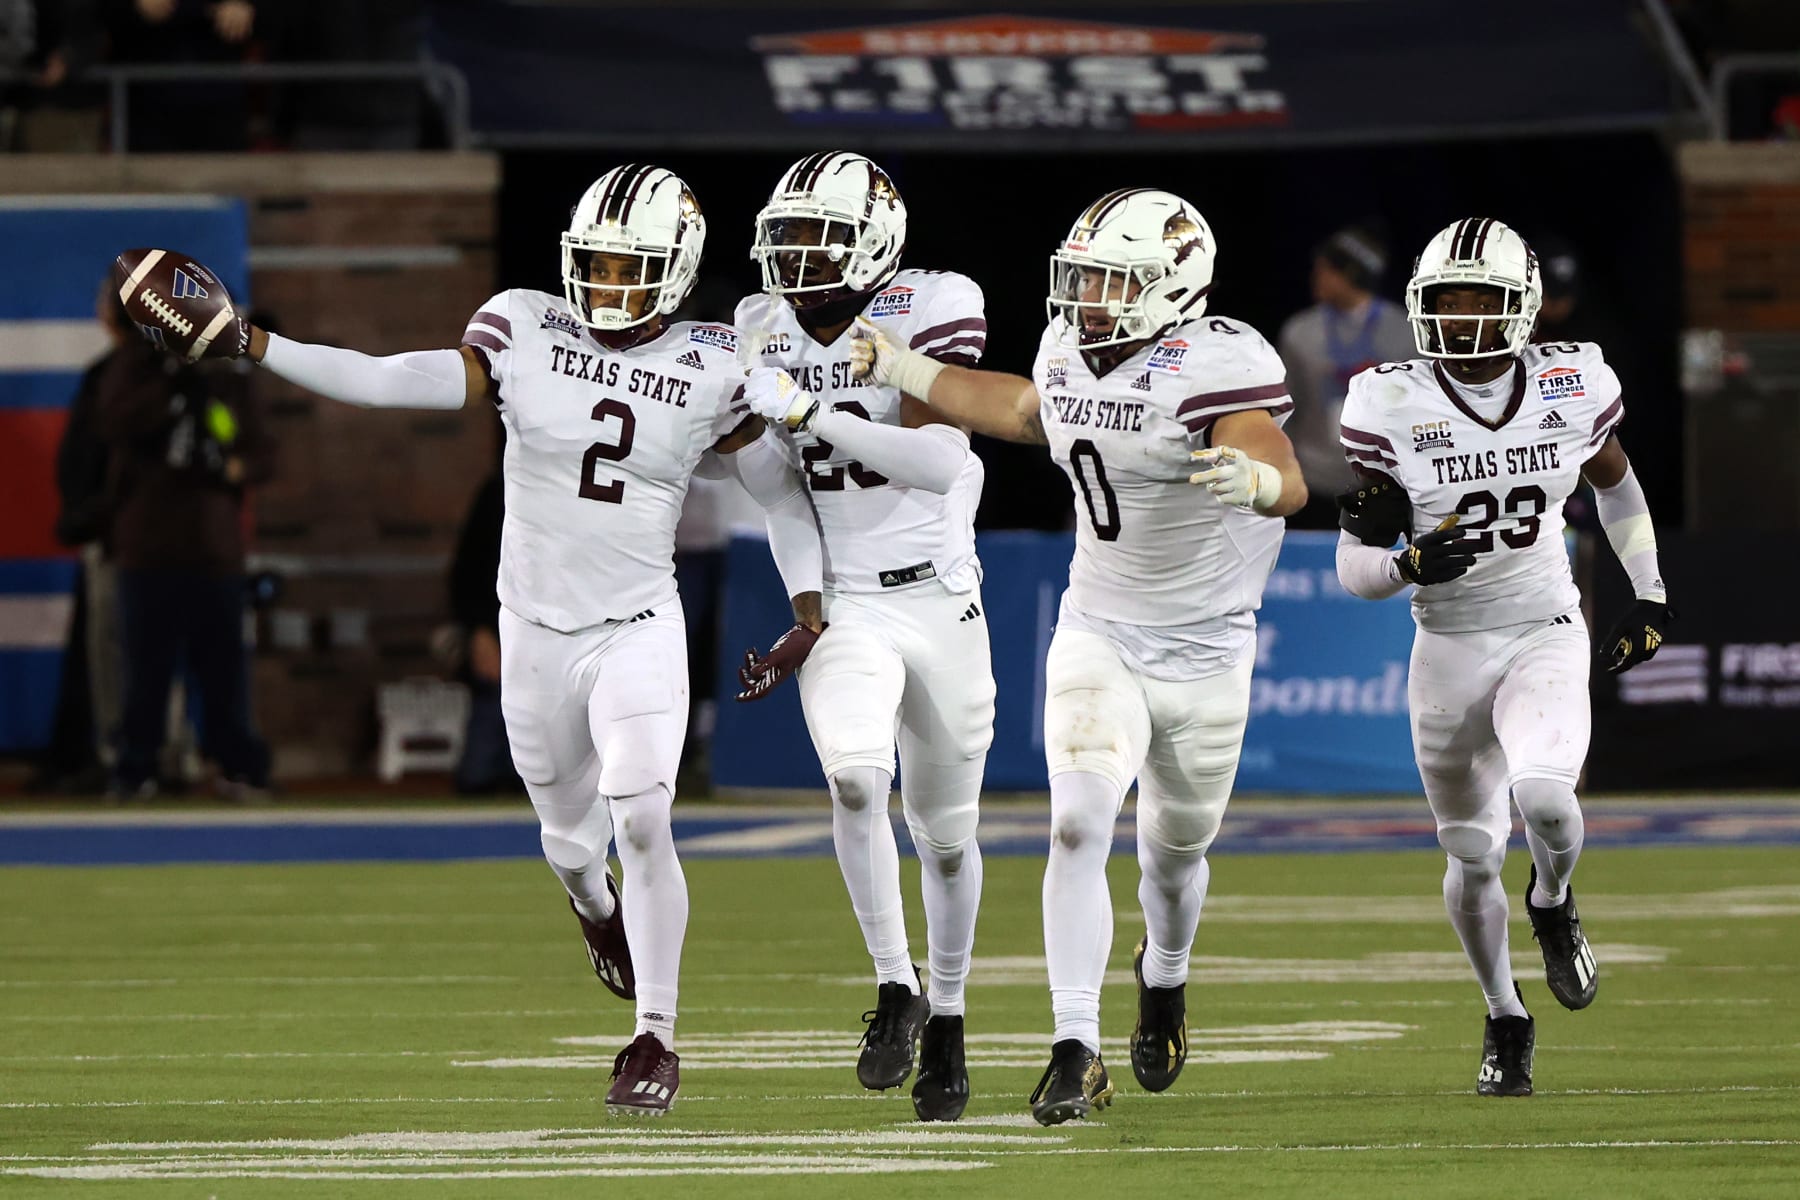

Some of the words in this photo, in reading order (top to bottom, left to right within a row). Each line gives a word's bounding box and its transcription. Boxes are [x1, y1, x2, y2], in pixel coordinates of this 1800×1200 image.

[761, 333, 791, 355] BC
[551, 345, 620, 388] TEXAS
[628, 368, 692, 409] STATE
[676, 357, 705, 371] adidas
[1541, 385, 1585, 396] RESPONDER
[1095, 400, 1145, 432] STATE
[1412, 420, 1452, 442] SBC
[1538, 420, 1567, 430] adidas
[578, 397, 636, 505] 2
[1432, 450, 1499, 485] TEXAS
[1506, 442, 1561, 475] STATE
[1070, 438, 1122, 542] 0
[1454, 484, 1547, 554] 23
